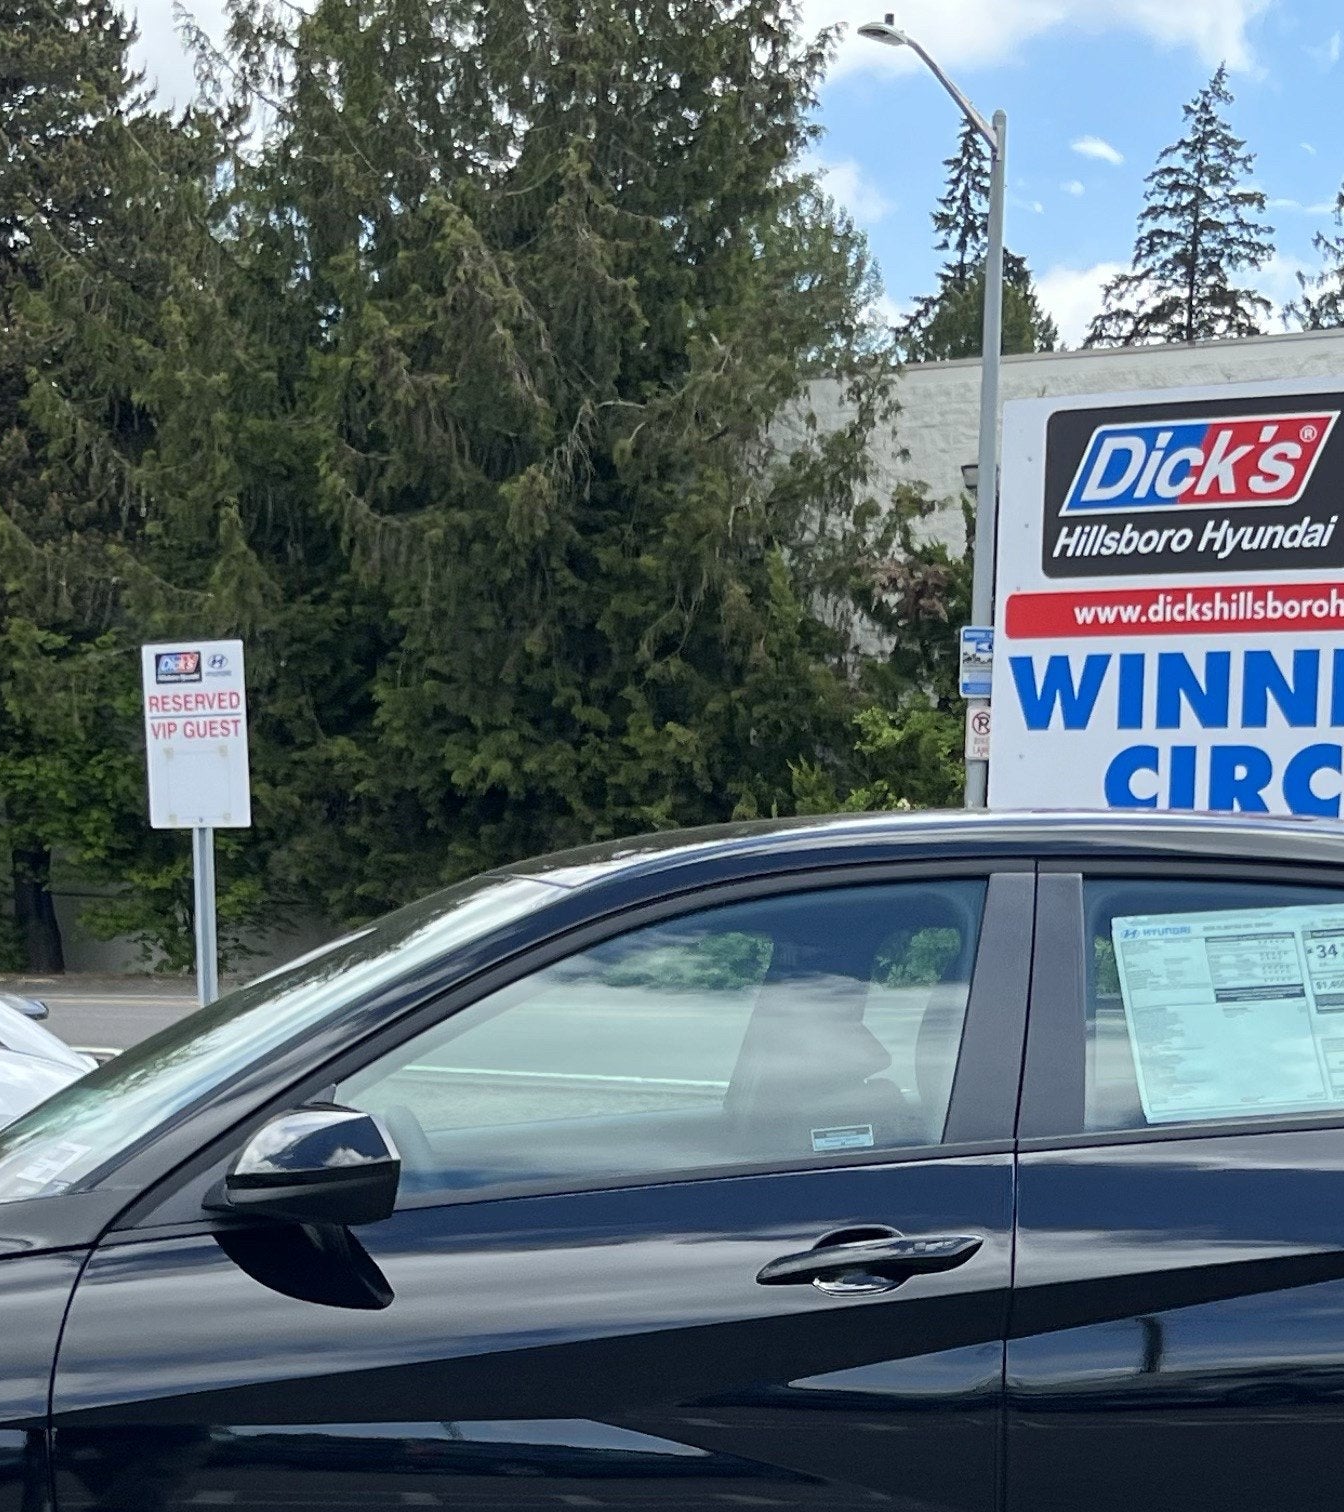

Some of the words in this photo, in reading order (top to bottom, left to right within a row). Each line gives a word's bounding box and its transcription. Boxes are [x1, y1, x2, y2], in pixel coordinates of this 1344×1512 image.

[1080, 425, 1302, 502] Dick's
[1052, 523, 1193, 558] Hillsboro
[1197, 515, 1339, 560] Hyundai
[148, 691, 240, 713] RESERVED
[150, 721, 177, 740] VIP
[183, 719, 241, 739] GUEST
[1142, 926, 1191, 938] HYUNDAI
[1316, 943, 1338, 959] 34
